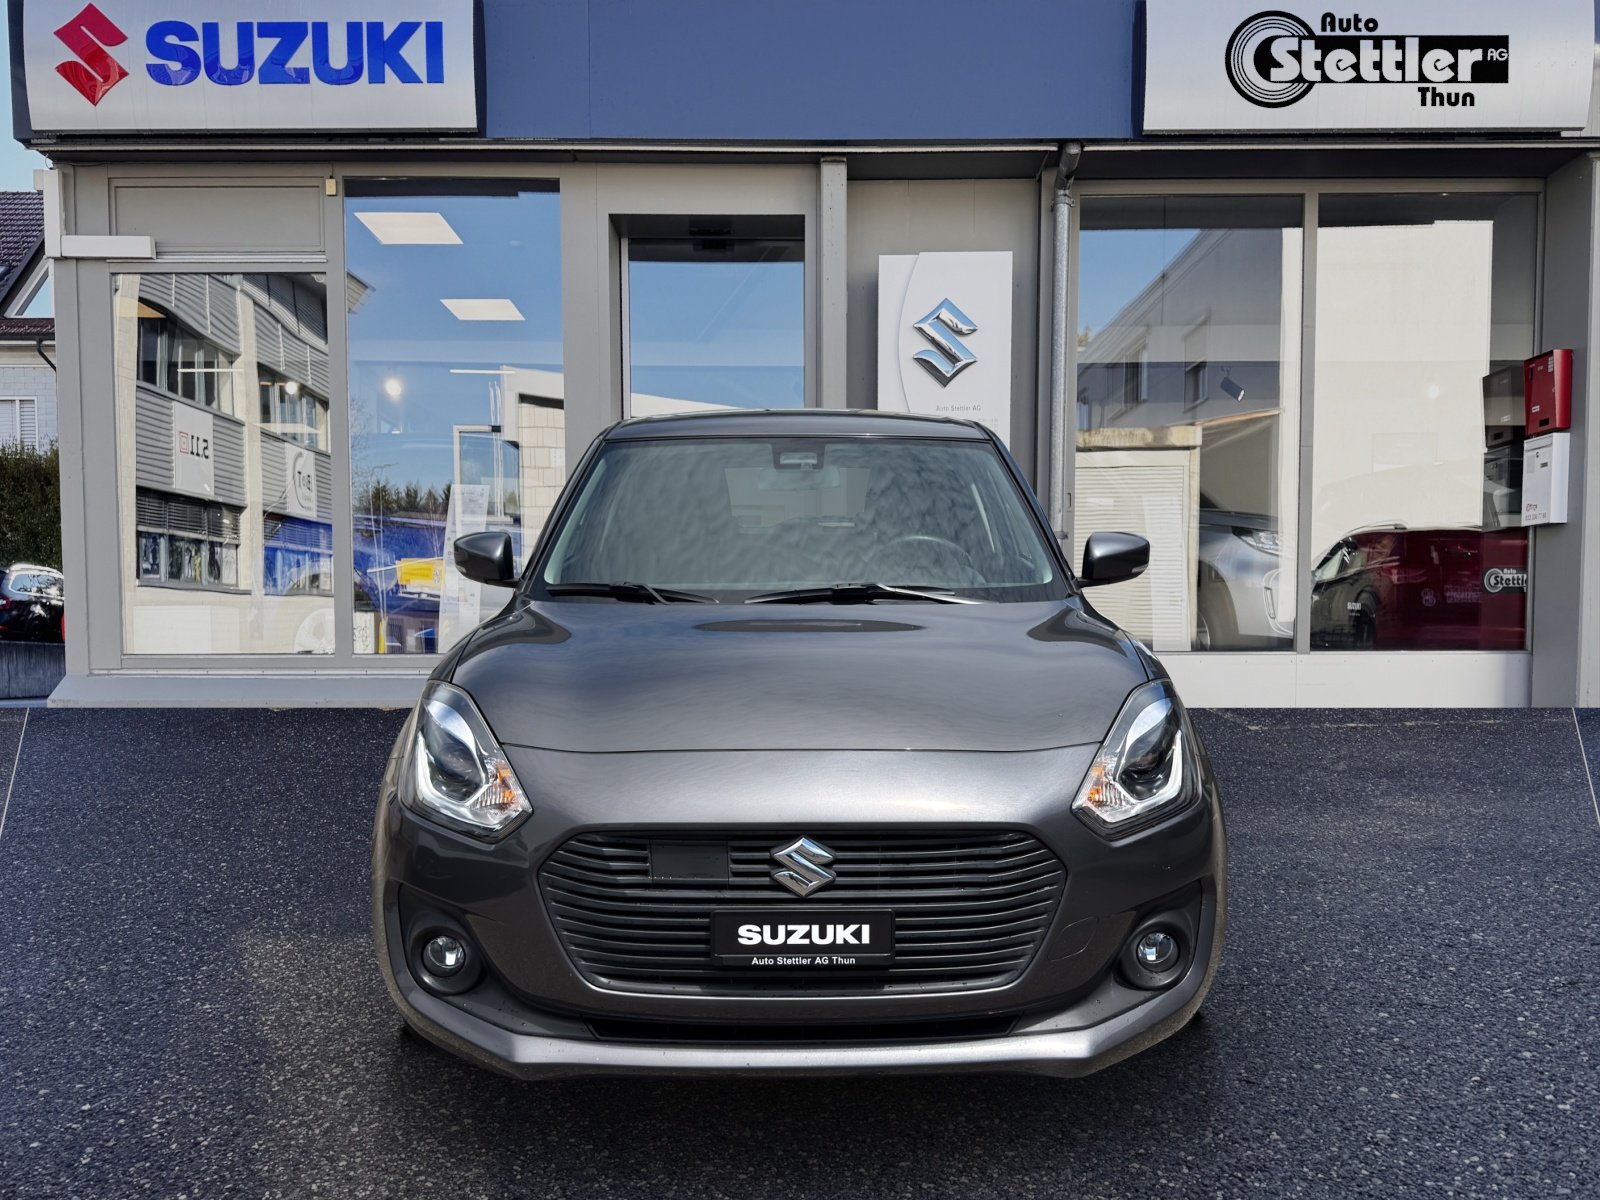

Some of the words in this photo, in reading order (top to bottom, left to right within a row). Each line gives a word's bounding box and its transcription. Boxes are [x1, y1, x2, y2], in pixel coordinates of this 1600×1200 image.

[1320, 12, 1379, 32] Auto
[145, 20, 444, 87] SUZUKI
[1269, 36, 1483, 82] Stettler
[1487, 48, 1508, 61] AG
[1417, 86, 1475, 107] Thun
[737, 924, 870, 945] SUZUKI
[752, 957, 774, 965] Auto
[777, 957, 812, 965] Stettler
[815, 957, 829, 965] AG
[832, 957, 856, 965] Thun
